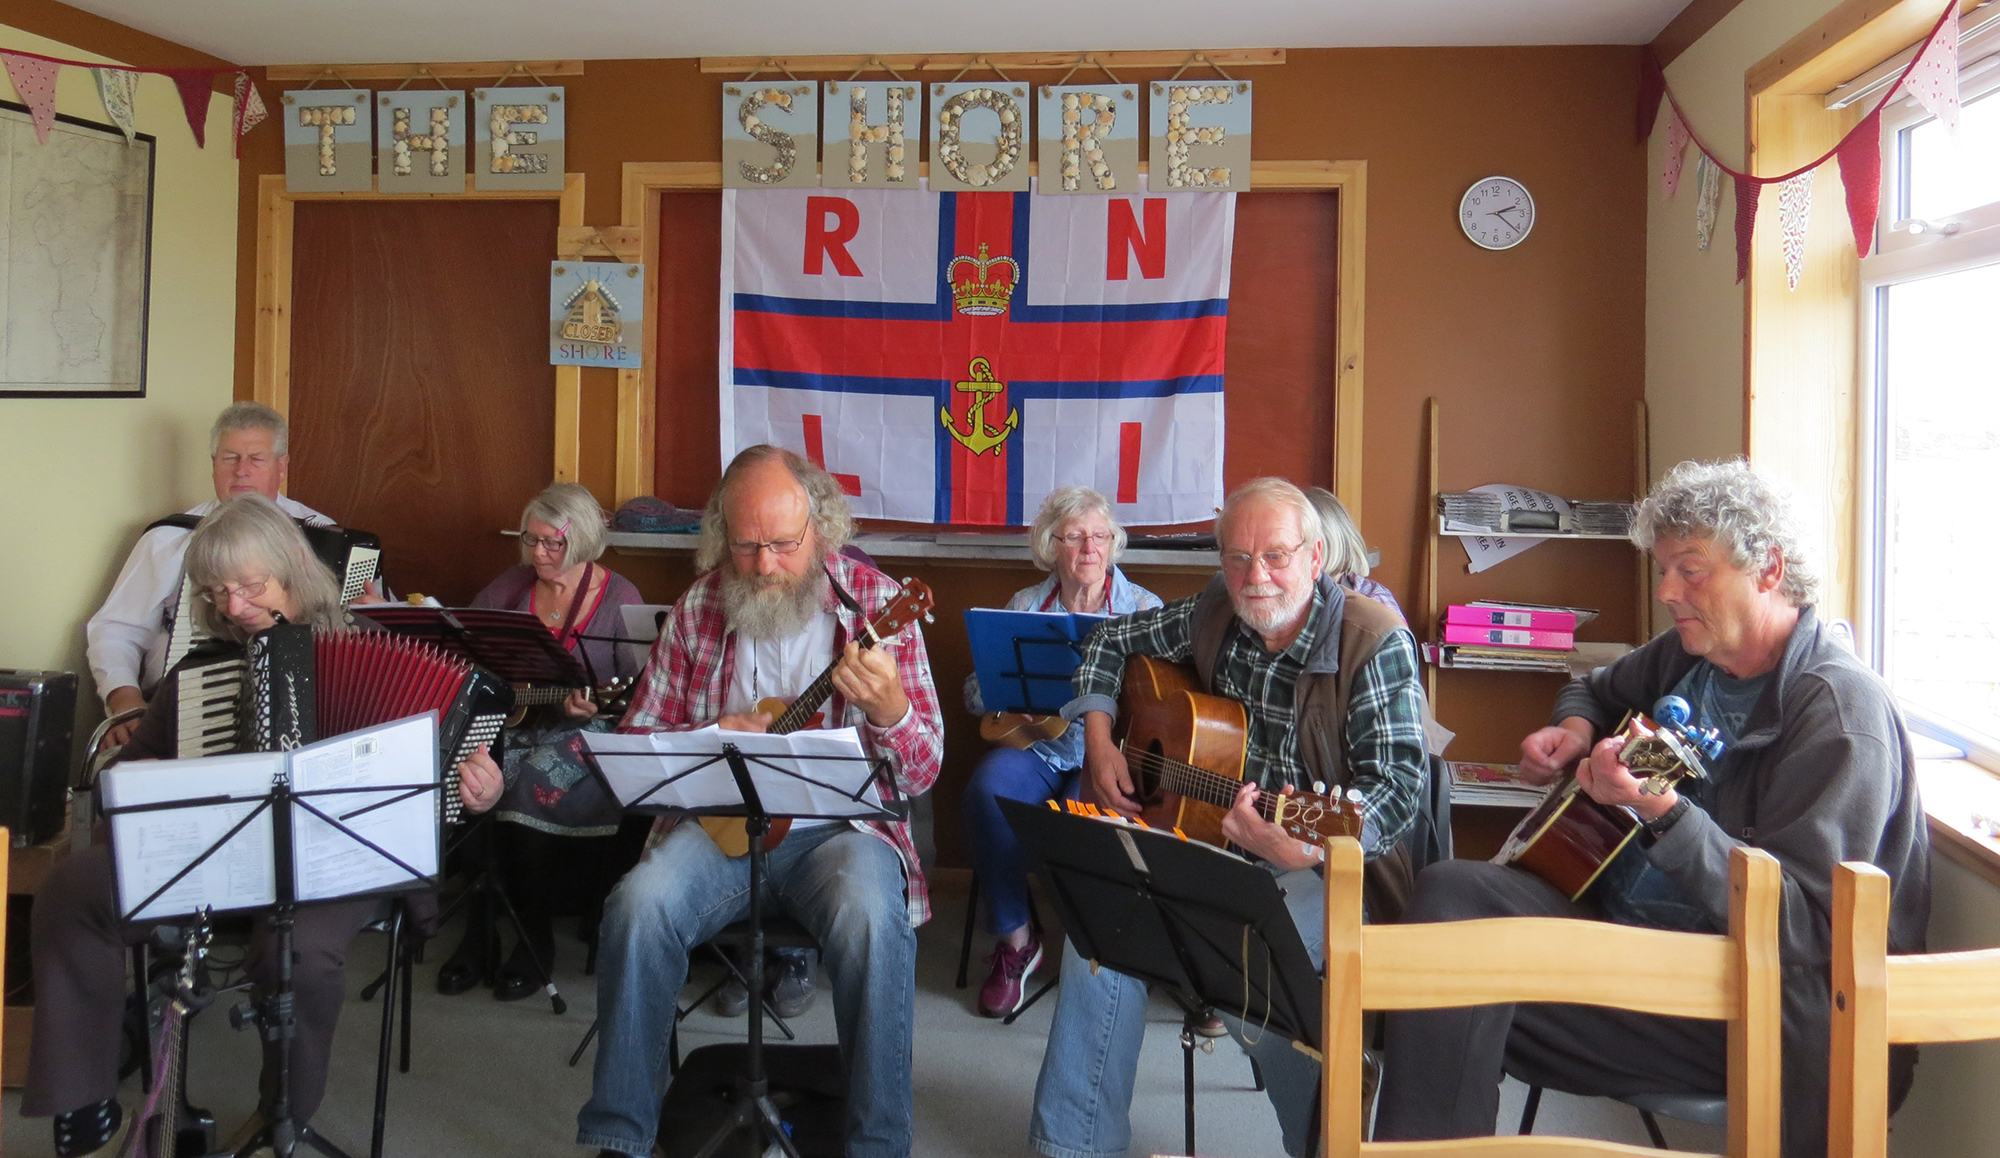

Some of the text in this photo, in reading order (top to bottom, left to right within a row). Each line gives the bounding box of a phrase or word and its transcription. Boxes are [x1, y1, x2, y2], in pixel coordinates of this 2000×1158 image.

[299, 86, 1233, 192] THE SHORE
[803, 196, 1167, 280] R N
[571, 266, 619, 286] THE
[564, 322, 614, 341] CLOSED
[559, 343, 627, 361] SHORE
[802, 414, 1142, 503] L I
[1506, 491, 1519, 506] AGE
[1496, 538, 1506, 549] IN
